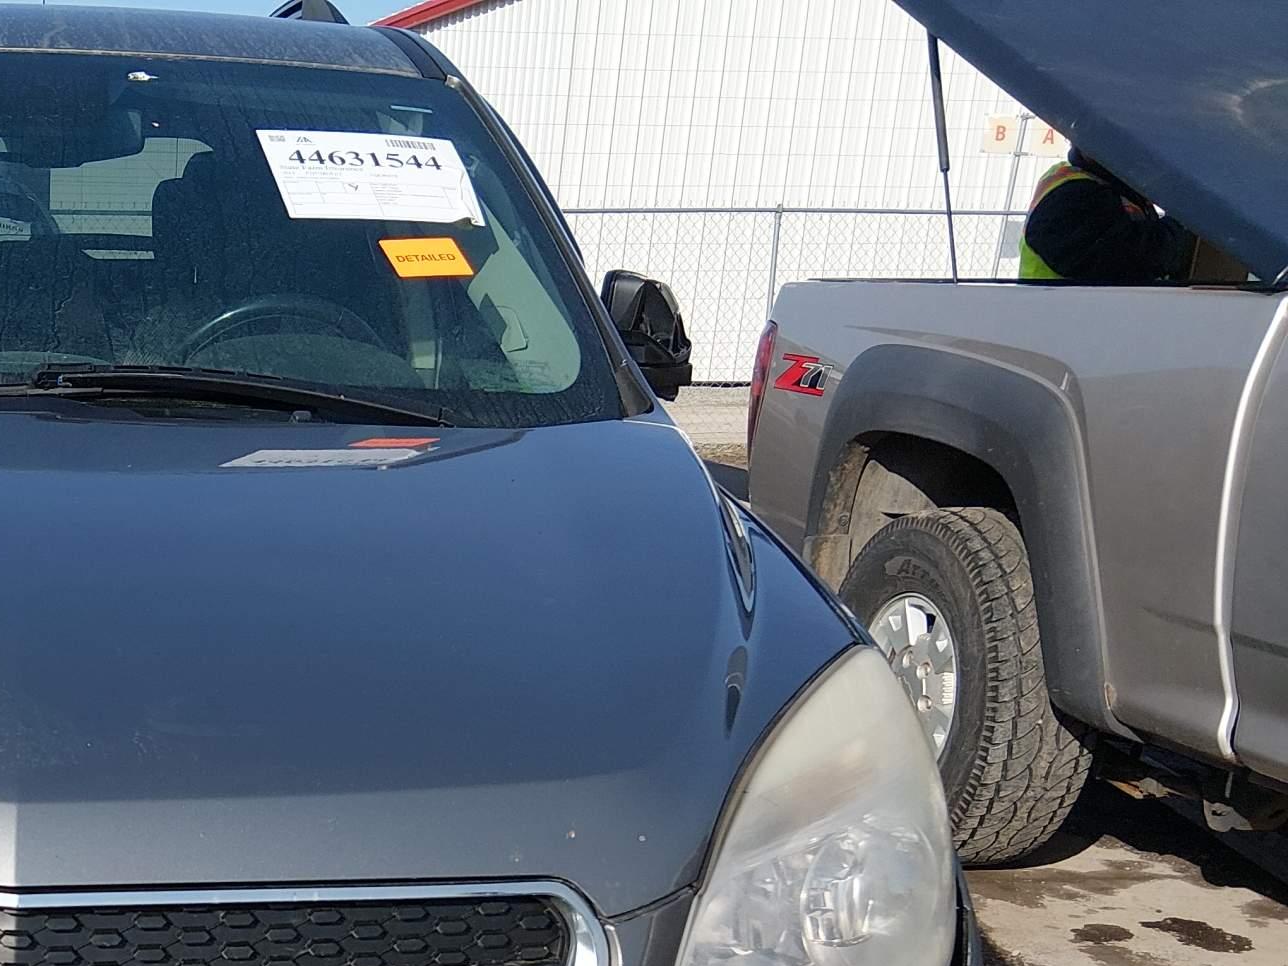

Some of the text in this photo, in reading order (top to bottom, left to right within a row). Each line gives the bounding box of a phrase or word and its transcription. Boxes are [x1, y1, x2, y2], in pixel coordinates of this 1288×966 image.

[995, 125, 1007, 141] B
[1042, 128, 1054, 145] A
[288, 149, 442, 171] 44631544
[395, 253, 456, 263] DETAILED
[774, 353, 834, 397] Z71
